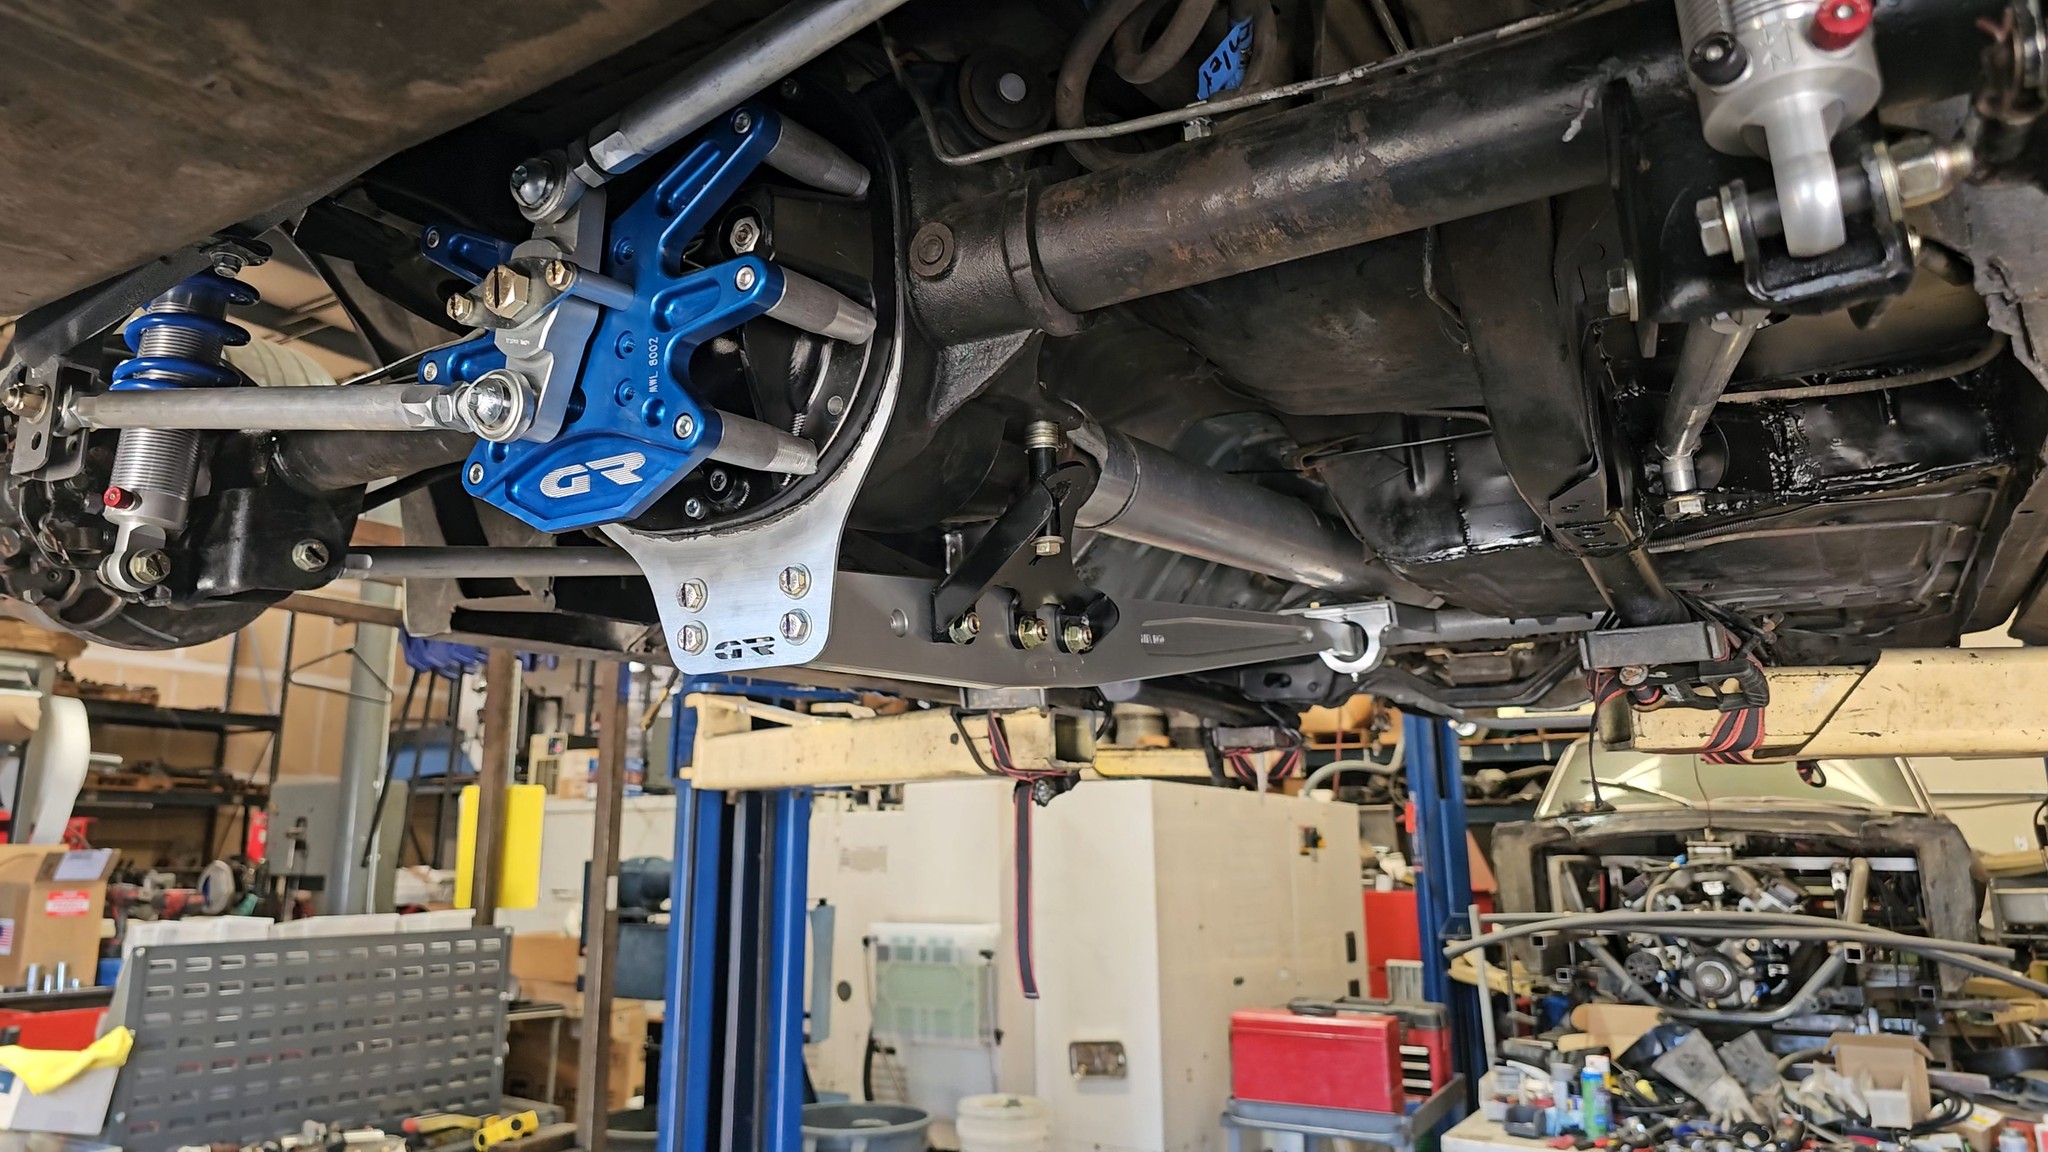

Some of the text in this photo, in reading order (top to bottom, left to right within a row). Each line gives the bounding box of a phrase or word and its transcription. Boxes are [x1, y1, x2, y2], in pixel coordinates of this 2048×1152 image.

[648, 337, 659, 393] MWL 8002
[539, 452, 646, 498] GR
[714, 636, 776, 660] GR
